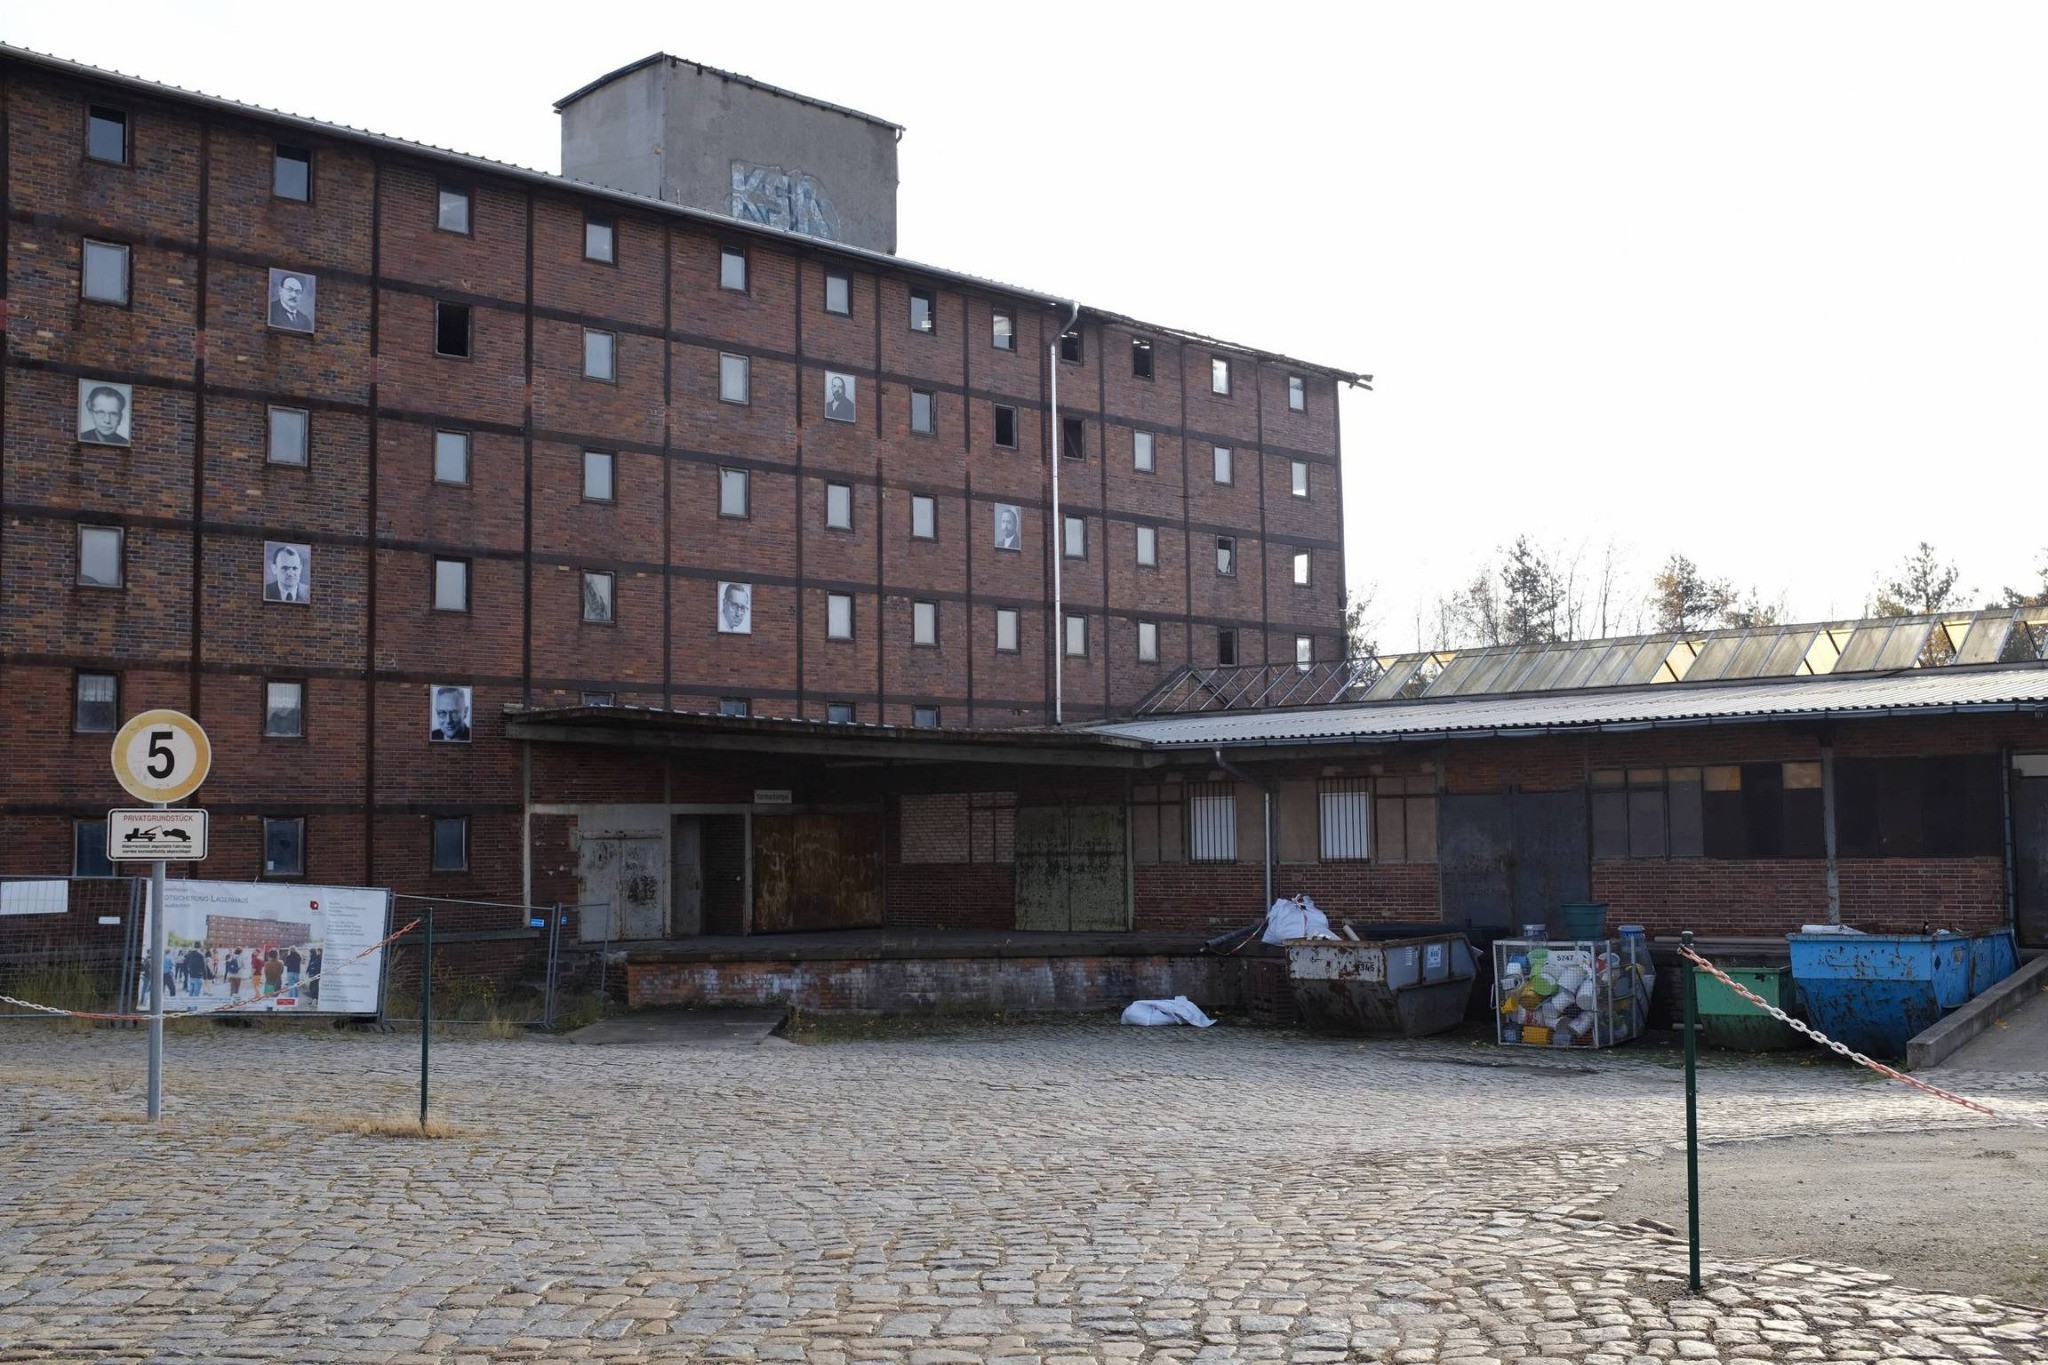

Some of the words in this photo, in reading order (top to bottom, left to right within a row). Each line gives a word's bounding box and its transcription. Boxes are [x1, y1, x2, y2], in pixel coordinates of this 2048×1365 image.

[147, 731, 175, 779] 5
[123, 814, 193, 822] PRIVATGRUNDSTÜCK
[164, 894, 209, 903] OTSICHERUNG
